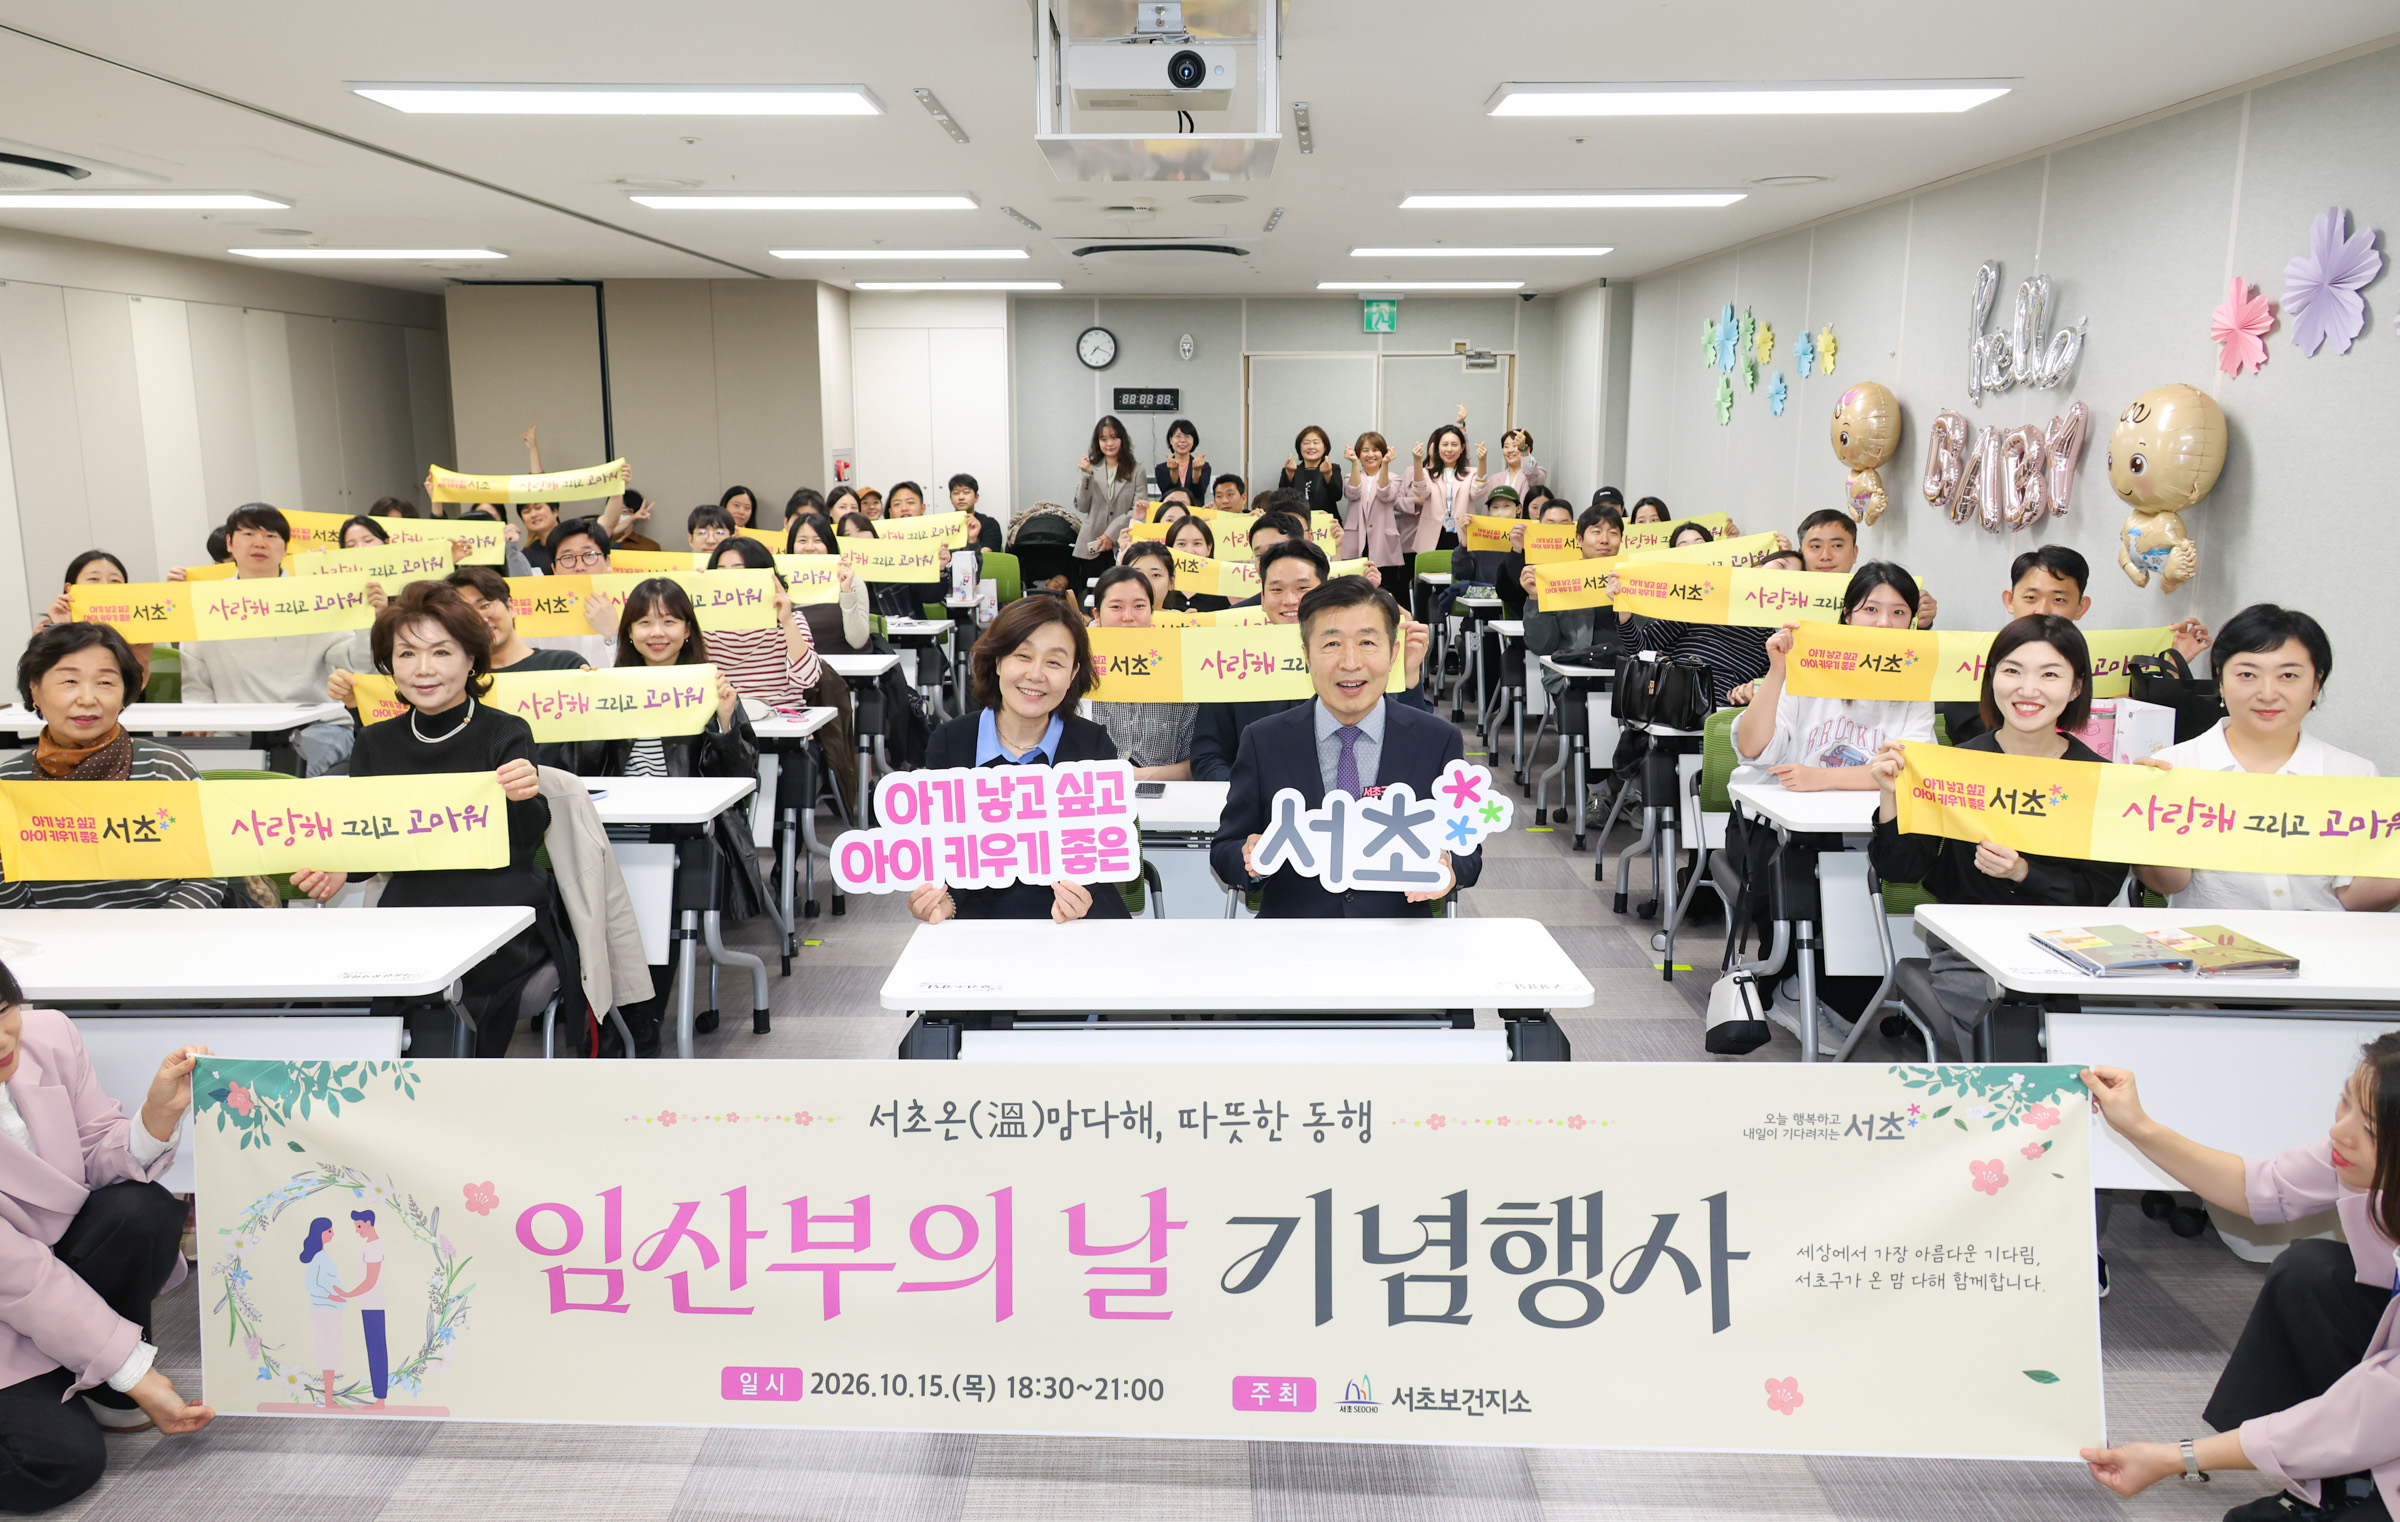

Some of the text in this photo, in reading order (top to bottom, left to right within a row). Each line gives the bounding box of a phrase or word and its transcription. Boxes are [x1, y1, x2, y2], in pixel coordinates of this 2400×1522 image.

[1923, 401, 2088, 533] BABY
[1222, 531, 1250, 548] 사랑
[401, 556, 444, 574] 고마워
[840, 550, 868, 566] 랑해
[898, 555, 934, 566] 고마워
[1174, 558, 1200, 574] 서초
[790, 570, 832, 584] 고마워
[1232, 564, 1262, 584] 사랑
[1584, 574, 1608, 590] 서초
[710, 588, 762, 606] 고마워
[1670, 584, 1703, 600] 서초
[1745, 586, 1808, 610] 사랑해
[134, 604, 168, 620] 서초
[209, 592, 363, 620] 사랑해 그리고 고마워
[535, 596, 569, 614] 서초
[1800, 658, 1818, 668] 아이
[1808, 648, 1825, 658] 아기
[1859, 654, 1902, 672] 서초
[1110, 654, 1150, 676] 서초
[1200, 648, 1310, 680] 사랑해 그리
[2092, 654, 2146, 676] 고마
[518, 687, 704, 720] 사랑해 그리고 고마워
[884, 771, 1127, 825] 아기 낳고 싶고
[1912, 787, 1936, 802] 아이
[1937, 793, 1966, 808] 키우기
[1923, 778, 1986, 797] 아기 낳고 싶고
[1989, 787, 2046, 816] 서초
[32, 816, 96, 829] 아기 낳고 싶고
[231, 804, 488, 846] 사랑해 그리고 고마워
[2122, 794, 2236, 835] 사랑해
[2243, 812, 2310, 838] 그리고
[20, 830, 48, 842] 아이
[50, 830, 78, 843] 키우기
[102, 814, 162, 844] 서초
[1258, 793, 1440, 884] 서초
[840, 827, 1130, 886] 아이 키우기 좋은
[1178, 1099, 1290, 1145] 따뜻한
[1302, 1099, 1372, 1144] 동행
[1764, 1112, 1841, 1126] 오늘 행복하고
[1844, 1112, 1906, 1142] 서초
[1743, 1128, 1841, 1141] 내일이 기다려지는
[515, 1185, 1751, 1334] 임산부의 날 기념행사
[1796, 1244, 2041, 1267] 세상에서 가장 아름다운 기다림,
[1795, 1272, 2046, 1293] 서초구가 온 맘 다해 함께합니다.
[810, 1372, 996, 1403] 2026.10.15.(목)
[1006, 1376, 1164, 1402] 18:30~21:00
[1353, 1406, 1378, 1414] SEOCHO
[1392, 1386, 1532, 1416] 서초보건지소
